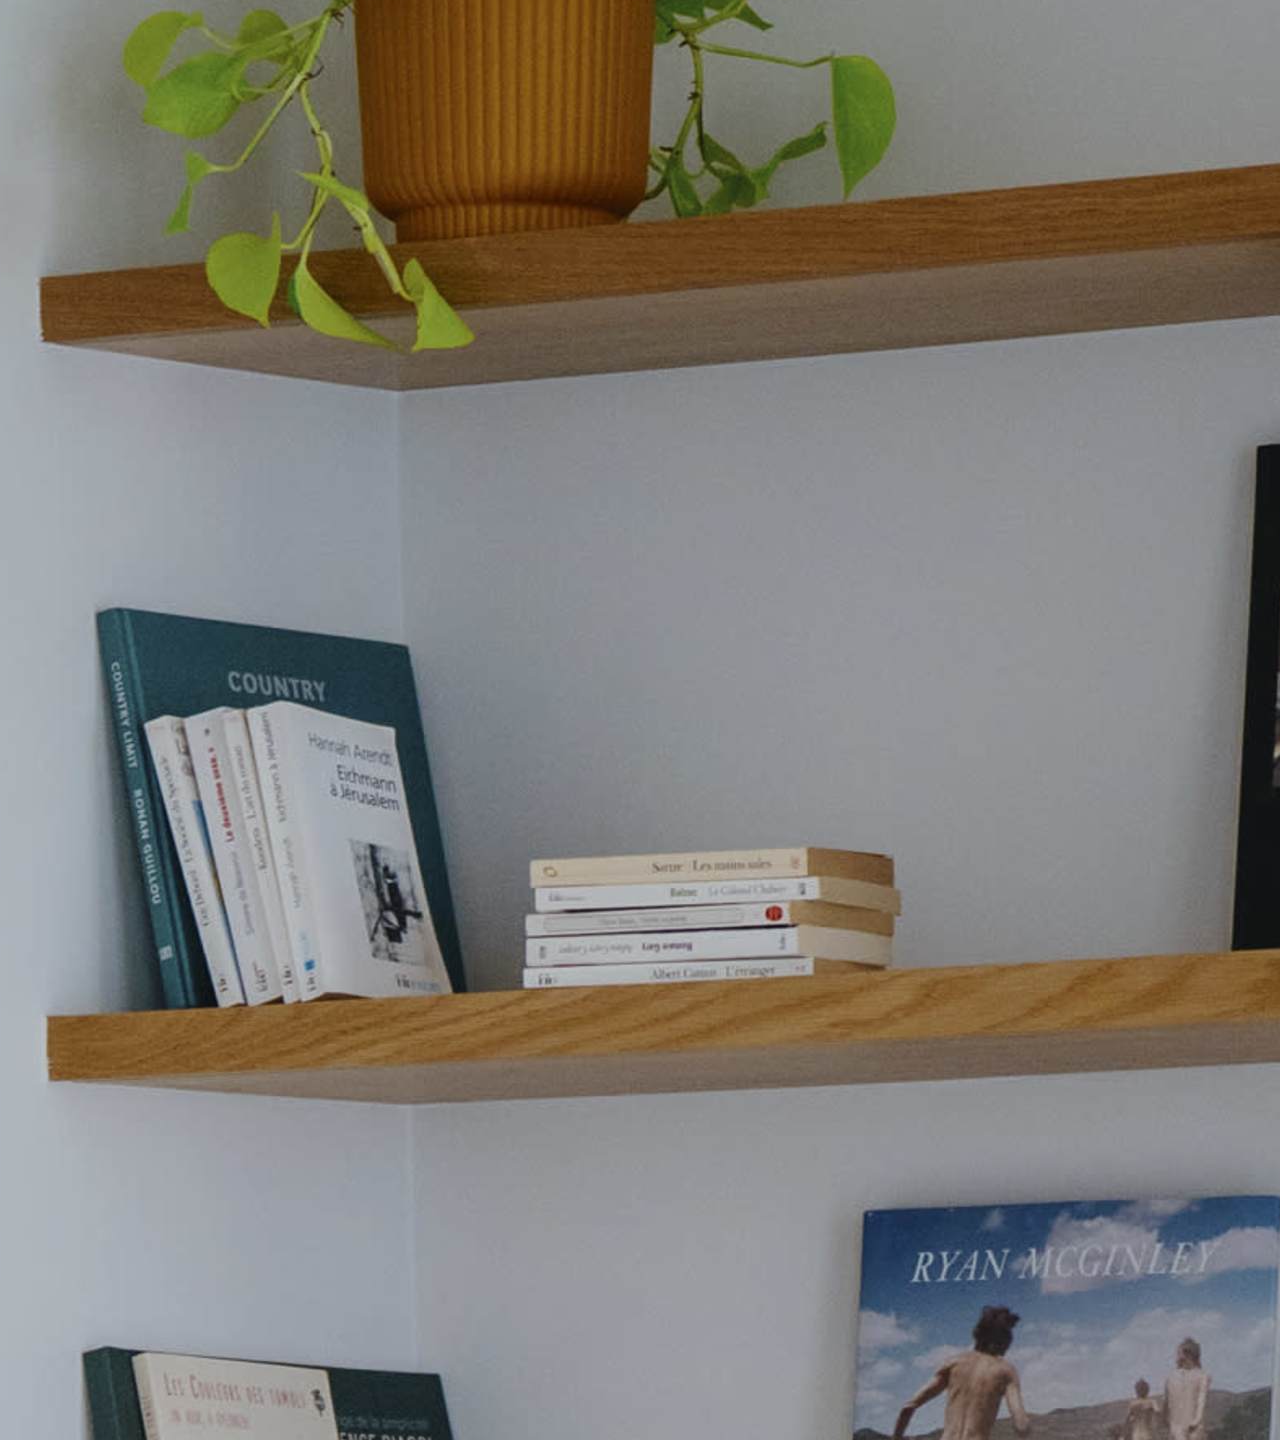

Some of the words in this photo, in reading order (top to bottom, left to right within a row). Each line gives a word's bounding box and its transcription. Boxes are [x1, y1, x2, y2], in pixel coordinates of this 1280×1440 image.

[228, 671, 325, 702] COUNTRY
[111, 661, 131, 727] COUNTRY
[123, 731, 138, 768] LIMIT
[308, 731, 351, 757] Hannah
[336, 763, 397, 794] Eichmann
[142, 844, 161, 904] GUILLOU
[911, 1250, 1009, 1282] RYAN
[1019, 1242, 1217, 1279] MCGINLEY
